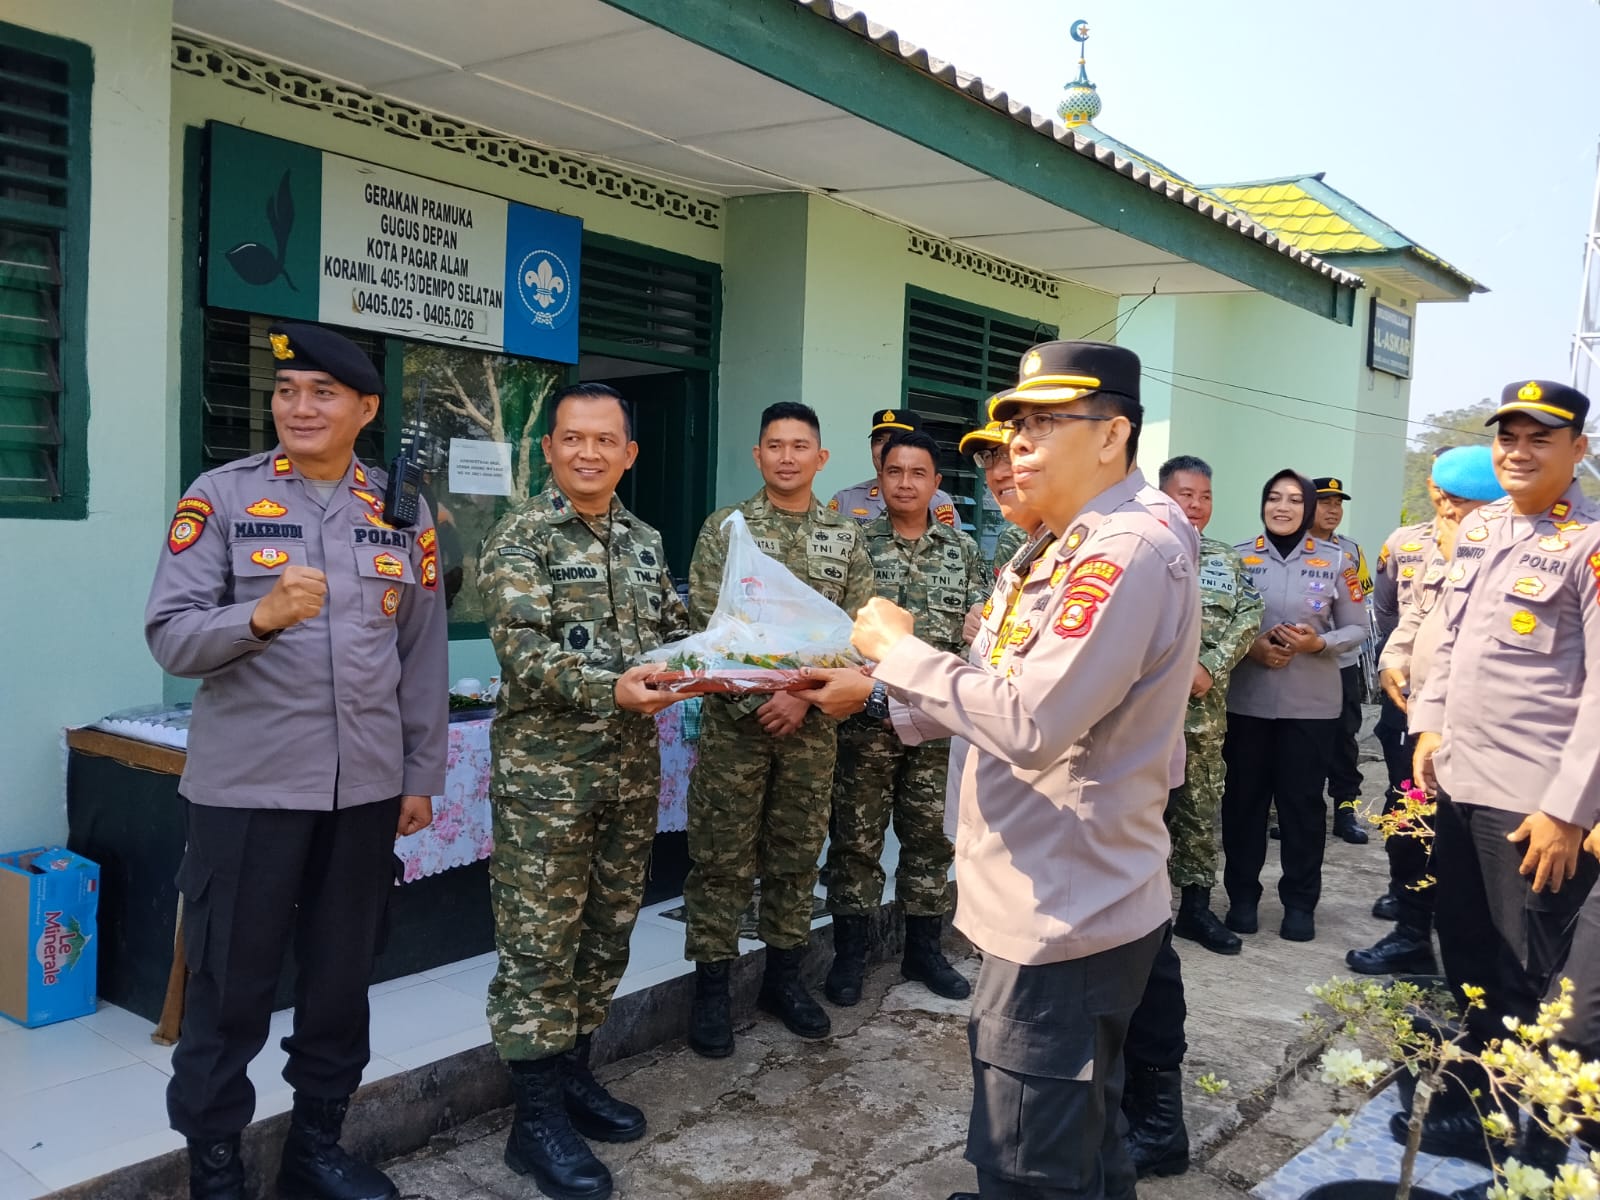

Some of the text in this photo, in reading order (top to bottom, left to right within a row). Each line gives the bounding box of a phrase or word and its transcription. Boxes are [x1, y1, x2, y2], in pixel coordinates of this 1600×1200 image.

[364, 183, 473, 228] GERAKAN PRAMUKA
[381, 214, 457, 250] GUGUS DEPAN
[367, 237, 469, 278] KOTA PAGAR ALAM
[324, 255, 377, 285] KORAMIL
[458, 283, 503, 309] SELATAN
[358, 290, 413, 319] 0405.025
[423, 302, 474, 330] 0405.026
[234, 522, 303, 539] MAKERUDI
[354, 528, 407, 548] POLRI
[812, 543, 832, 554] TNI
[1301, 569, 1335, 581] POLRI
[1519, 553, 1567, 577] POLRI
[931, 575, 951, 585] TNI
[1201, 578, 1233, 591] TNI AD
[43, 910, 63, 986] Minerale
[58, 931, 76, 955] Le
